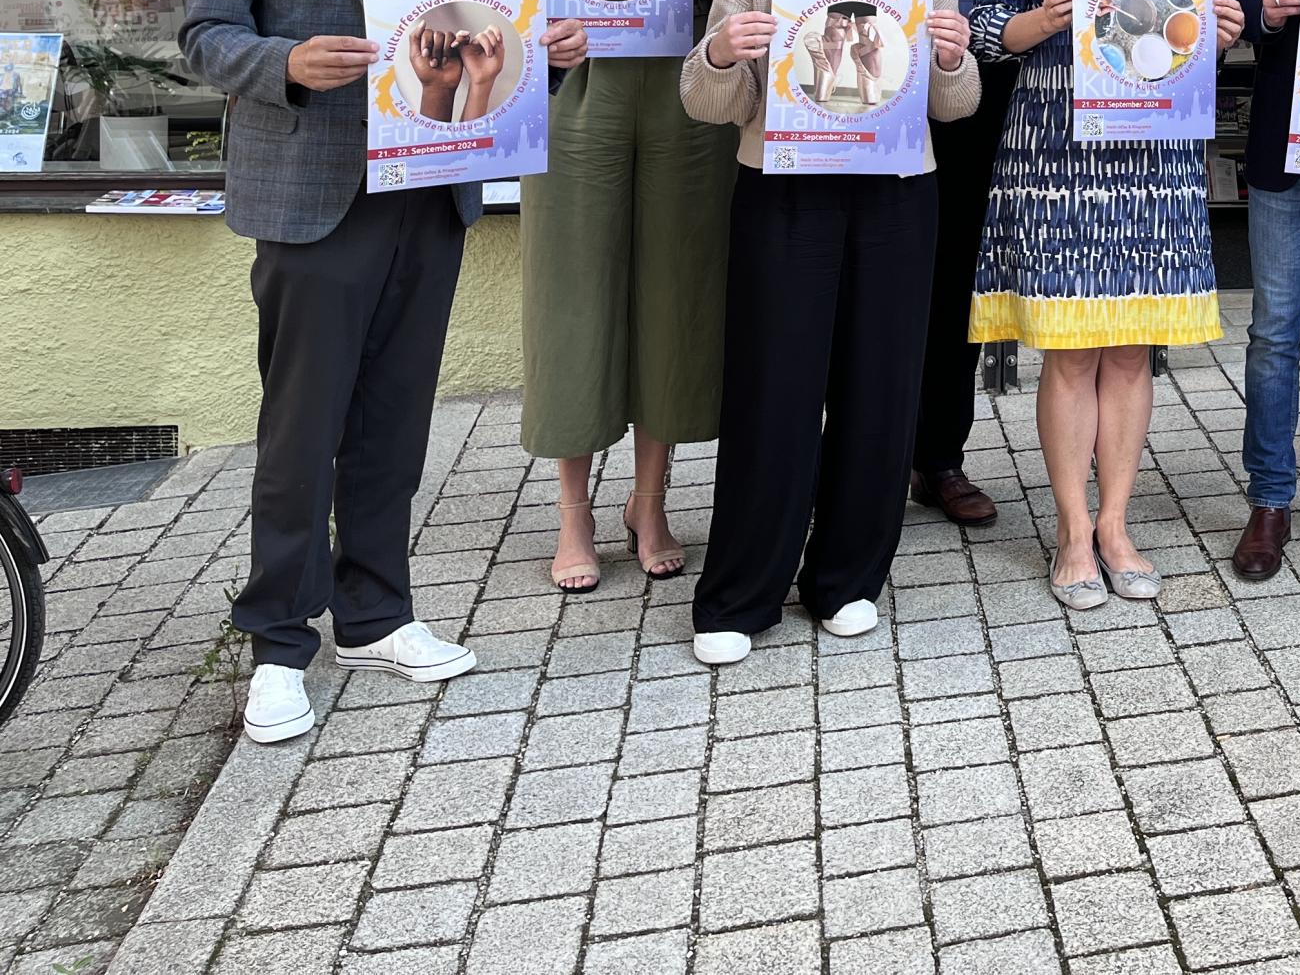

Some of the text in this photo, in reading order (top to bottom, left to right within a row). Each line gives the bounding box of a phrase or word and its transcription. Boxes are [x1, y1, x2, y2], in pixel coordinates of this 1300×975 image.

[772, 104, 847, 129] Tanz
[378, 123, 424, 145] Für
[802, 133, 841, 142] September
[411, 144, 455, 155] September
[457, 141, 477, 149] 2024
